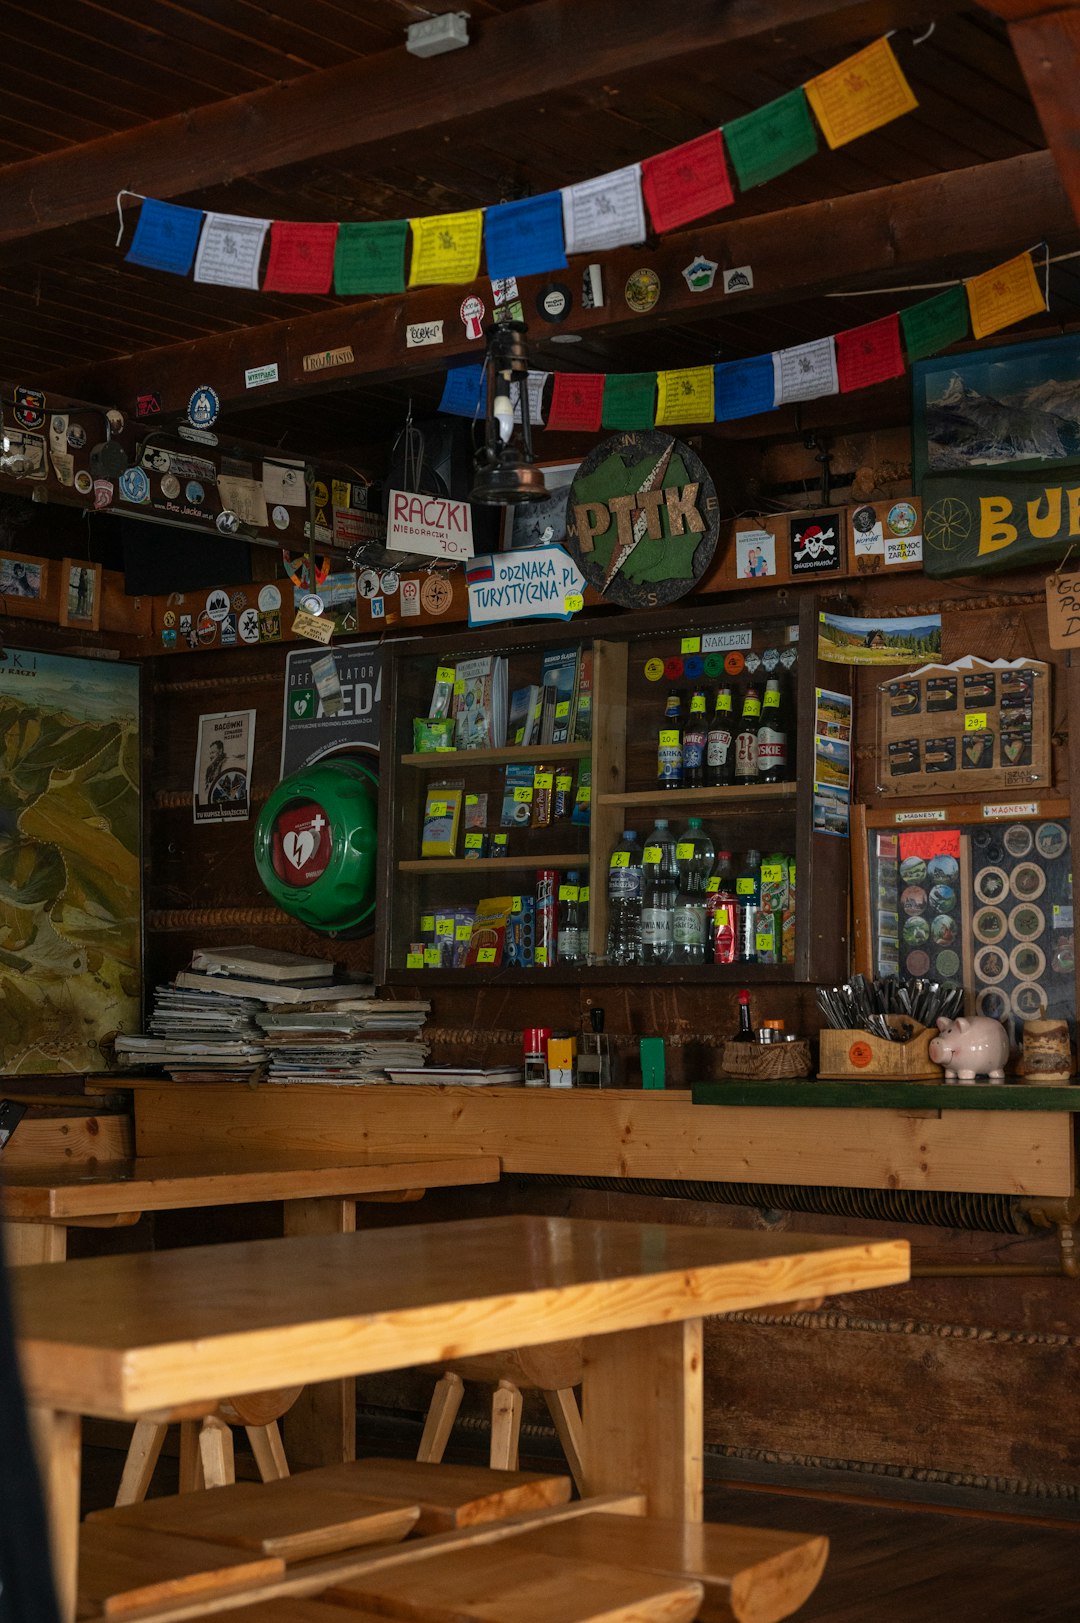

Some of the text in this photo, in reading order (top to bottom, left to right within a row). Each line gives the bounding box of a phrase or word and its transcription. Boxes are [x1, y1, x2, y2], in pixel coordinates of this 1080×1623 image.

[394, 494, 468, 532] RACZKI
[574, 482, 706, 553] PTTK
[394, 524, 448, 539] NIEBORACZKI
[888, 542, 920, 552] PRZEMOC
[500, 560, 556, 582] ODZNAKA
[473, 580, 559, 608] TURYSTYCZNA
[704, 634, 750, 648] NAKLEJKI
[290, 666, 374, 686] DEFILATOR
[214, 720, 243, 731] BACÓWKI
[991, 806, 1028, 814] MAGNESY
